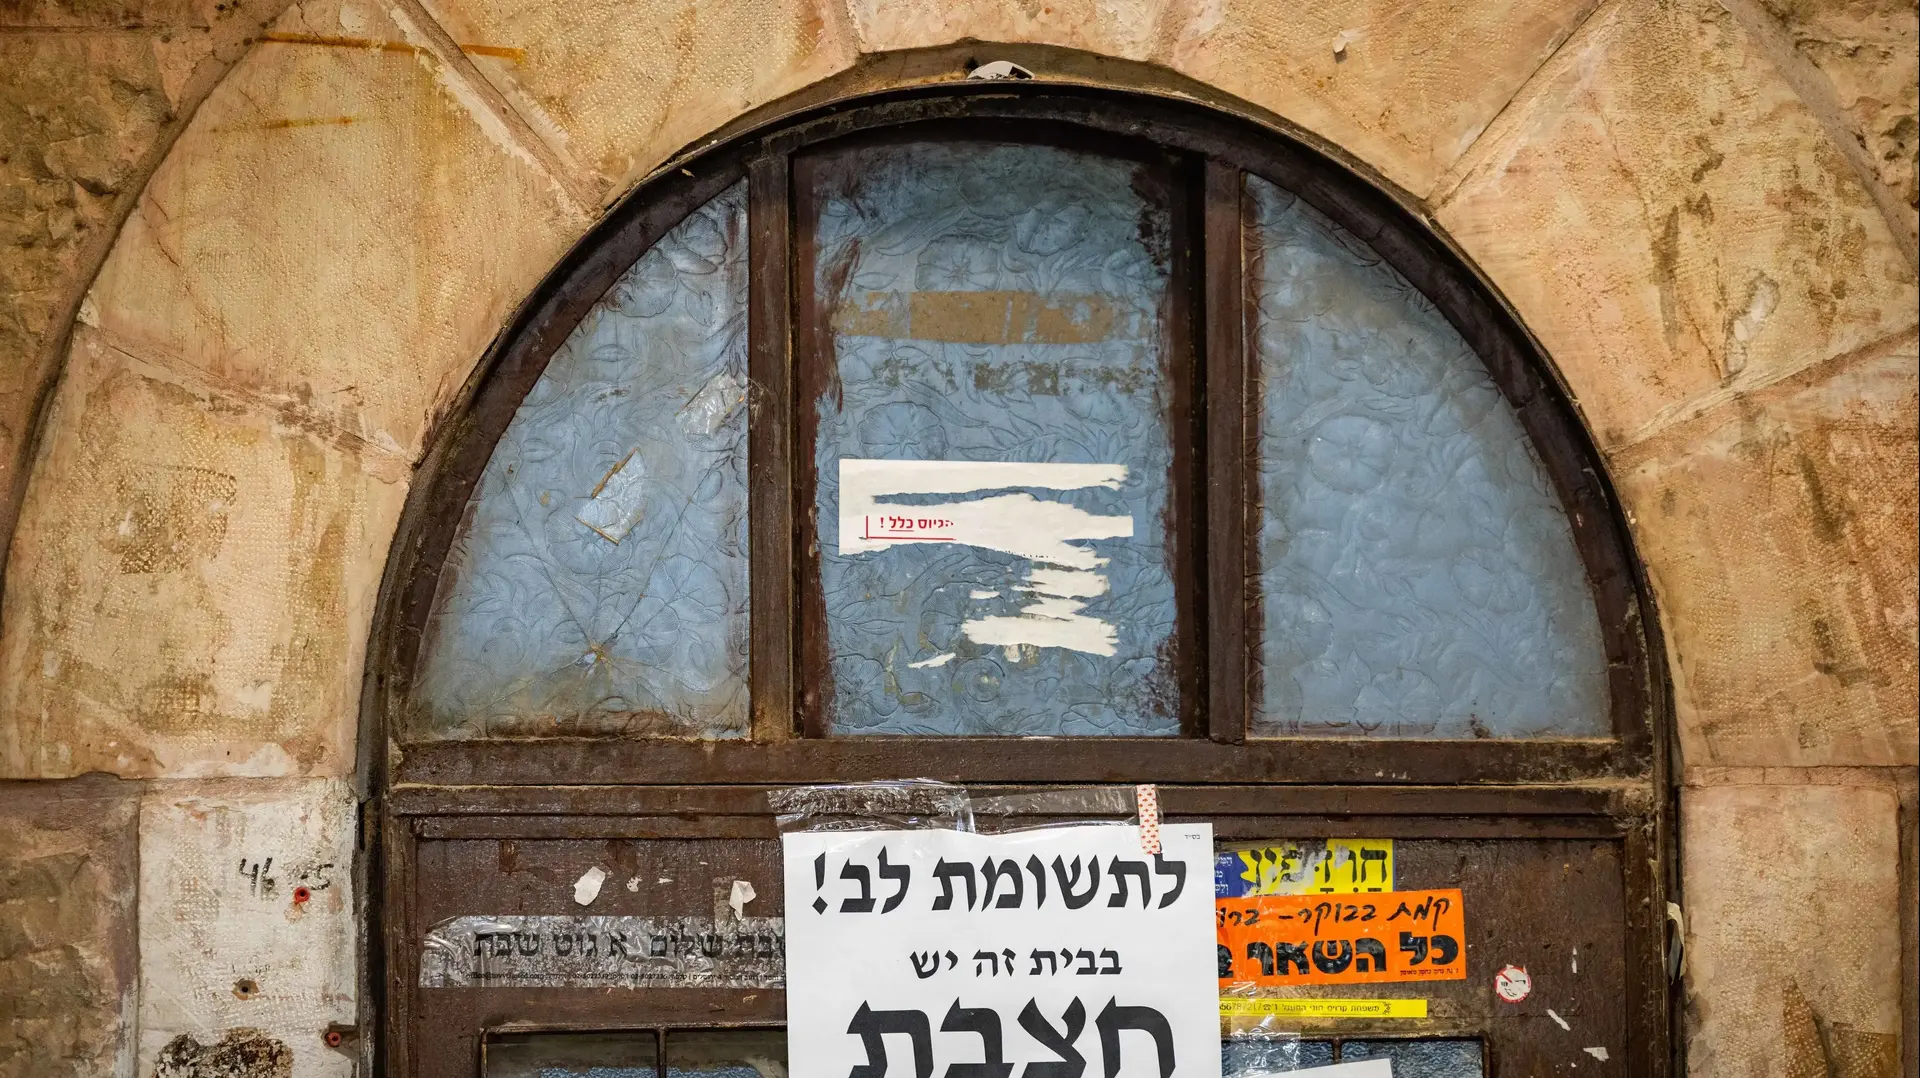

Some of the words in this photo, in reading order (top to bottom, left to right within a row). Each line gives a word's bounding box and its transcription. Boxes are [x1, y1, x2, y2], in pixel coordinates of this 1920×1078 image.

[888, 515, 914, 529] כלל
[811, 845, 911, 915] לב!
[931, 843, 1187, 912] לתשומת
[1386, 896, 1450, 932] קמת
[473, 931, 540, 957] שבת
[552, 931, 598, 958] גוט
[608, 931, 628, 958] א
[648, 923, 724, 958] שלום
[1247, 937, 1387, 977] השאר
[1399, 931, 1459, 966] כל
[909, 946, 960, 980] יש
[973, 946, 1018, 978] זה
[1029, 946, 1124, 977] בבית
[1350, 1004, 1380, 1012] משפחת
[846, 995, 1177, 1078] חצבת
